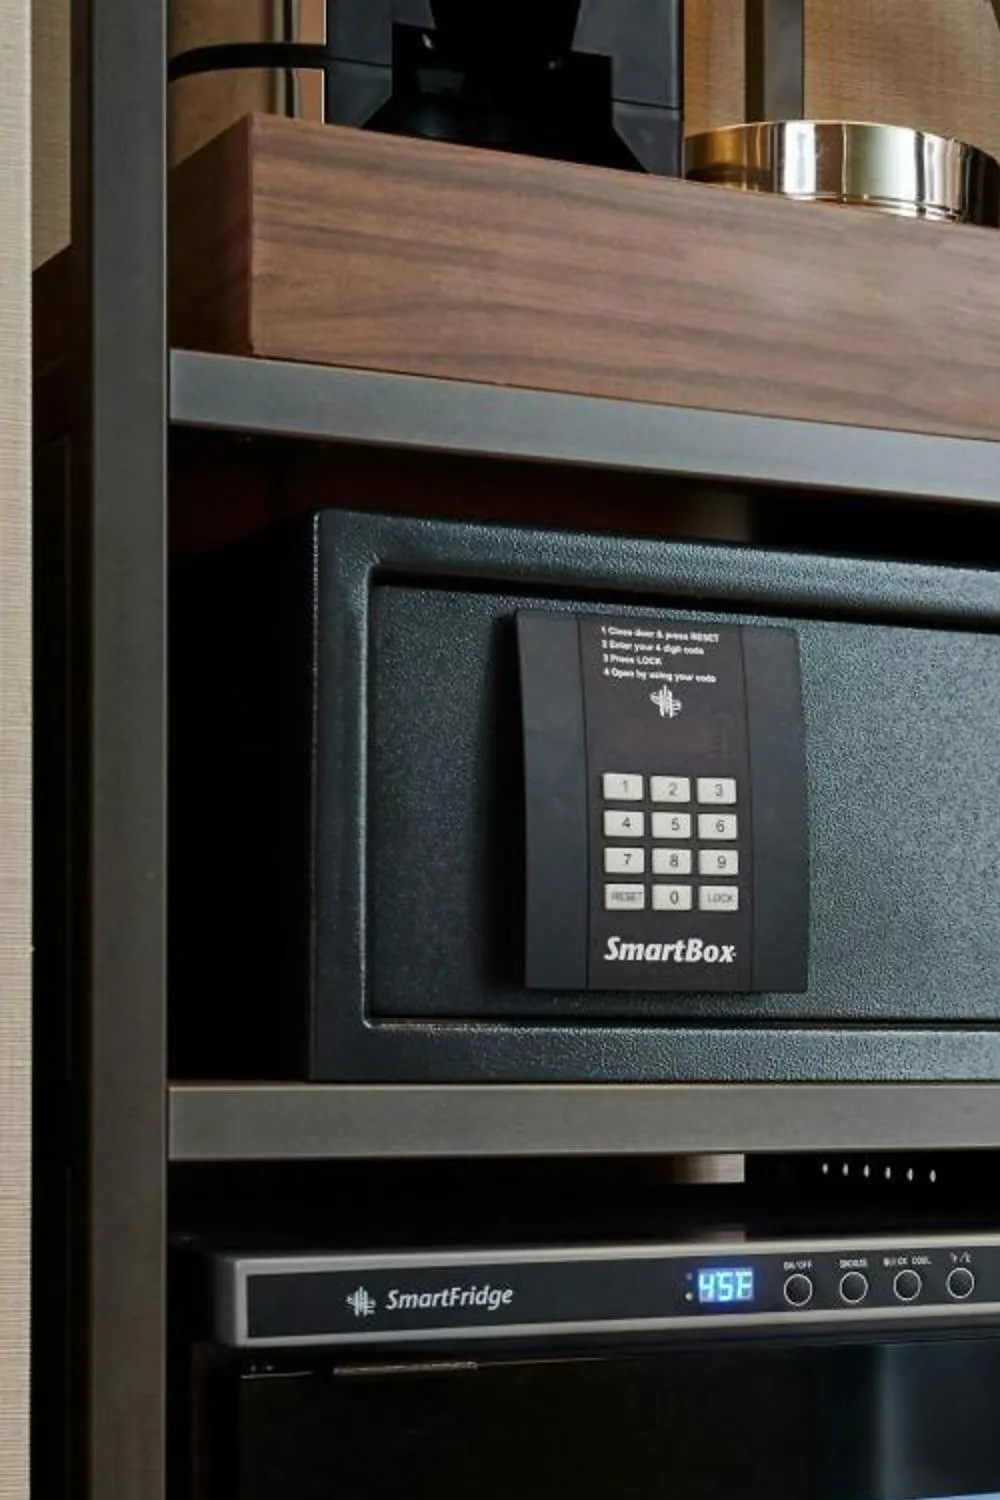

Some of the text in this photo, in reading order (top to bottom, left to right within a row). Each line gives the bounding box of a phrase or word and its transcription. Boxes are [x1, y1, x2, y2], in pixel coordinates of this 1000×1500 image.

[608, 627, 633, 637] Close
[634, 629, 654, 638] door
[690, 633, 719, 643] RESET
[609, 640, 632, 649] Enter
[634, 643, 654, 652] your
[684, 646, 704, 655] code
[603, 654, 608, 662] 3
[610, 654, 634, 664] Press
[603, 667, 609, 676] 4
[611, 668, 634, 678] Open
[636, 669, 647, 680] by
[649, 671, 673, 682] using
[673, 673, 694, 682] your
[622, 780, 724, 797] 1 2 3
[622, 817, 725, 833] 4 5 6
[623, 854, 727, 869] 7 8 9
[669, 890, 679, 905] 0
[707, 893, 733, 904] LOCK
[603, 935, 735, 963] SmartBox
[386, 1285, 514, 1311] SmartFridge
